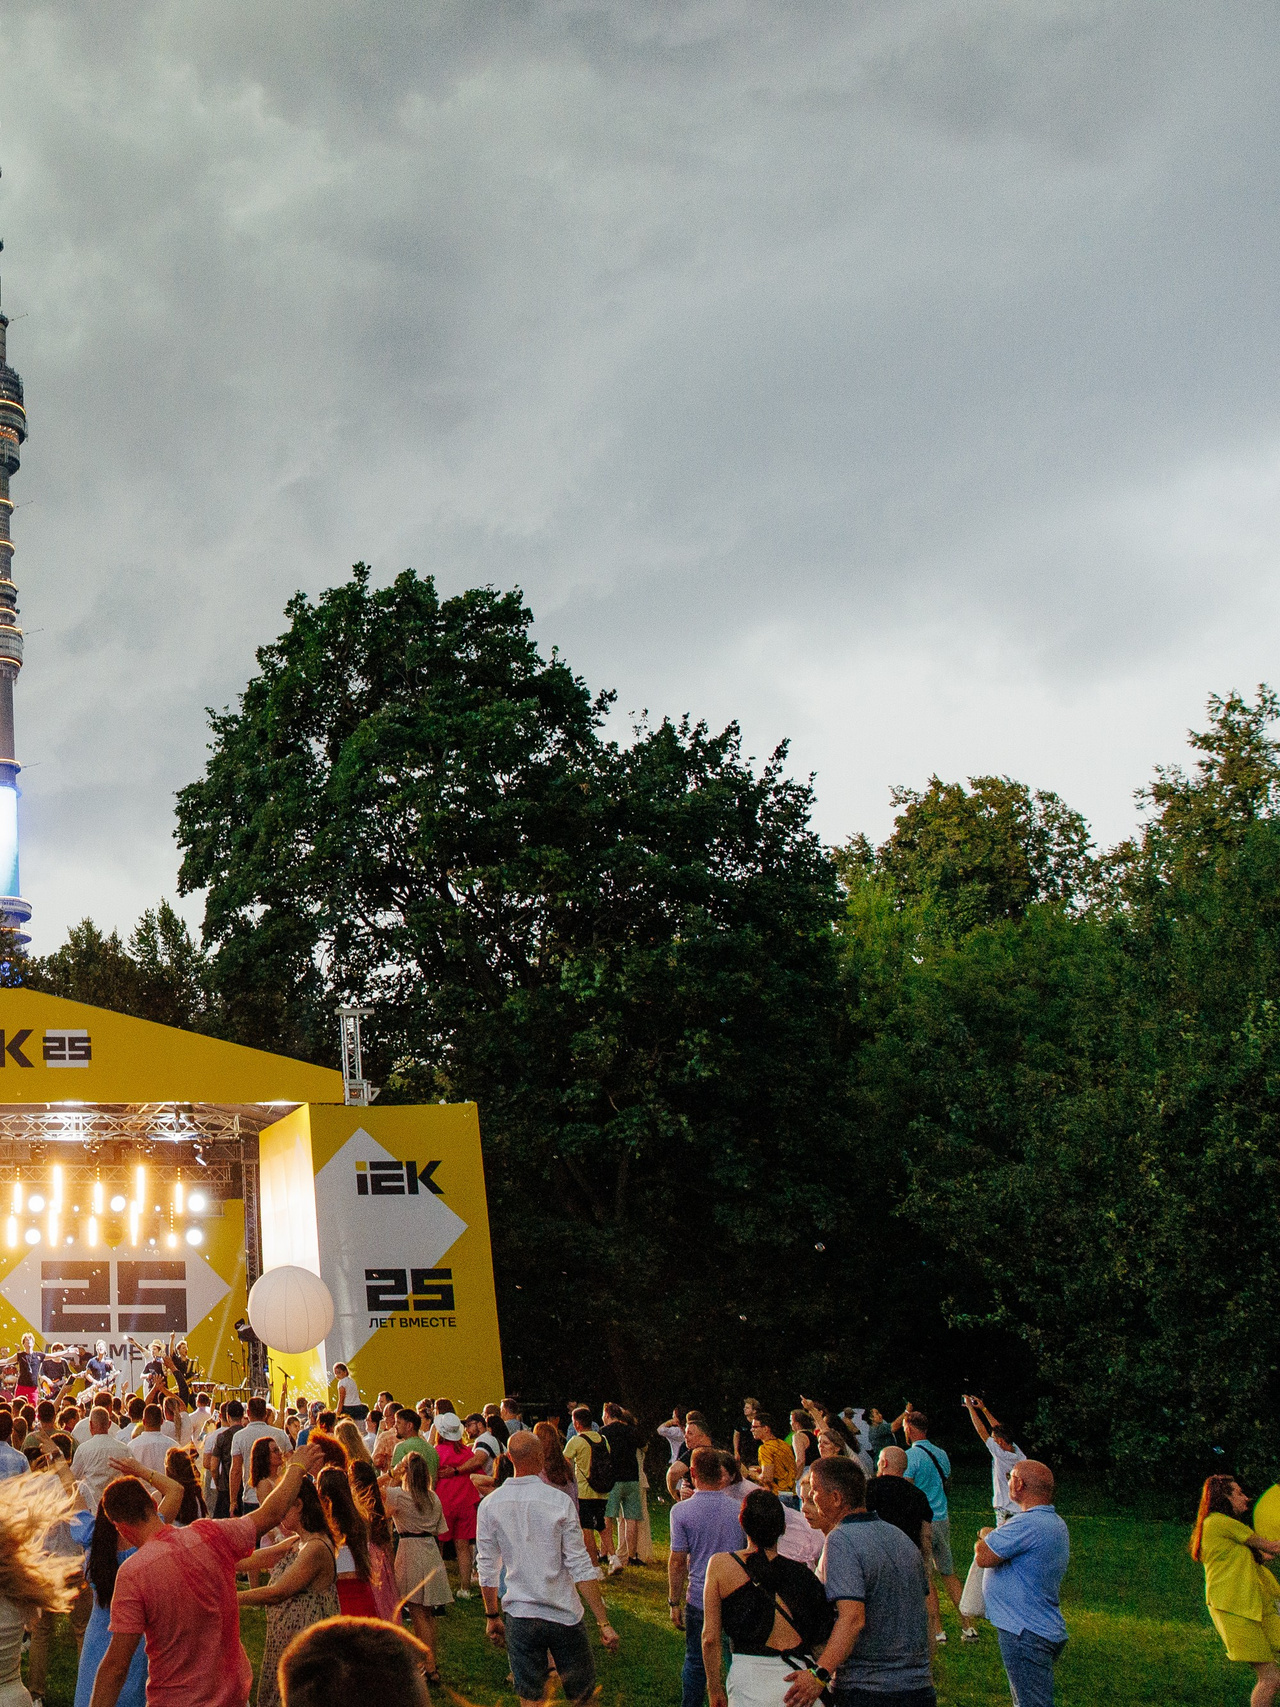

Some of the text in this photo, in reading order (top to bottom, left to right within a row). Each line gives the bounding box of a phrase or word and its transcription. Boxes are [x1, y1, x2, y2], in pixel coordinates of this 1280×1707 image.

[42, 1036, 92, 1061] 25
[40, 1260, 188, 1333] 25
[364, 1268, 456, 1312] 25
[368, 1316, 457, 1329] ЛЕТ ВМЕСТЕ
